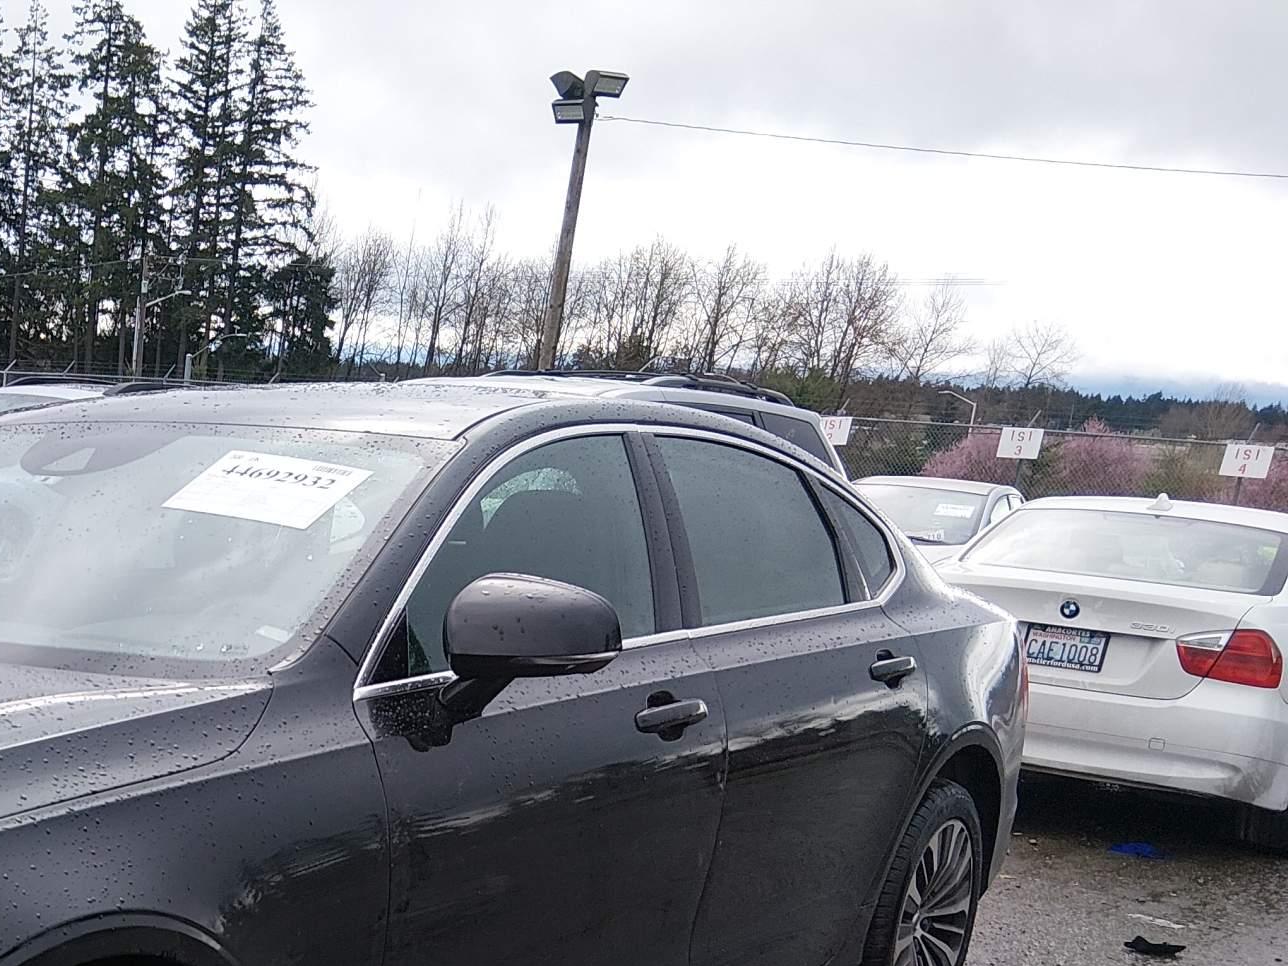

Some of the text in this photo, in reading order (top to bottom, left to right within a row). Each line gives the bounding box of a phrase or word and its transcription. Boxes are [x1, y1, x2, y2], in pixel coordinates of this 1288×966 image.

[1014, 445, 1023, 456] 3
[222, 464, 337, 490] 44692932
[1238, 463, 1247, 475] 4
[1027, 638, 1100, 664] CAE1008
